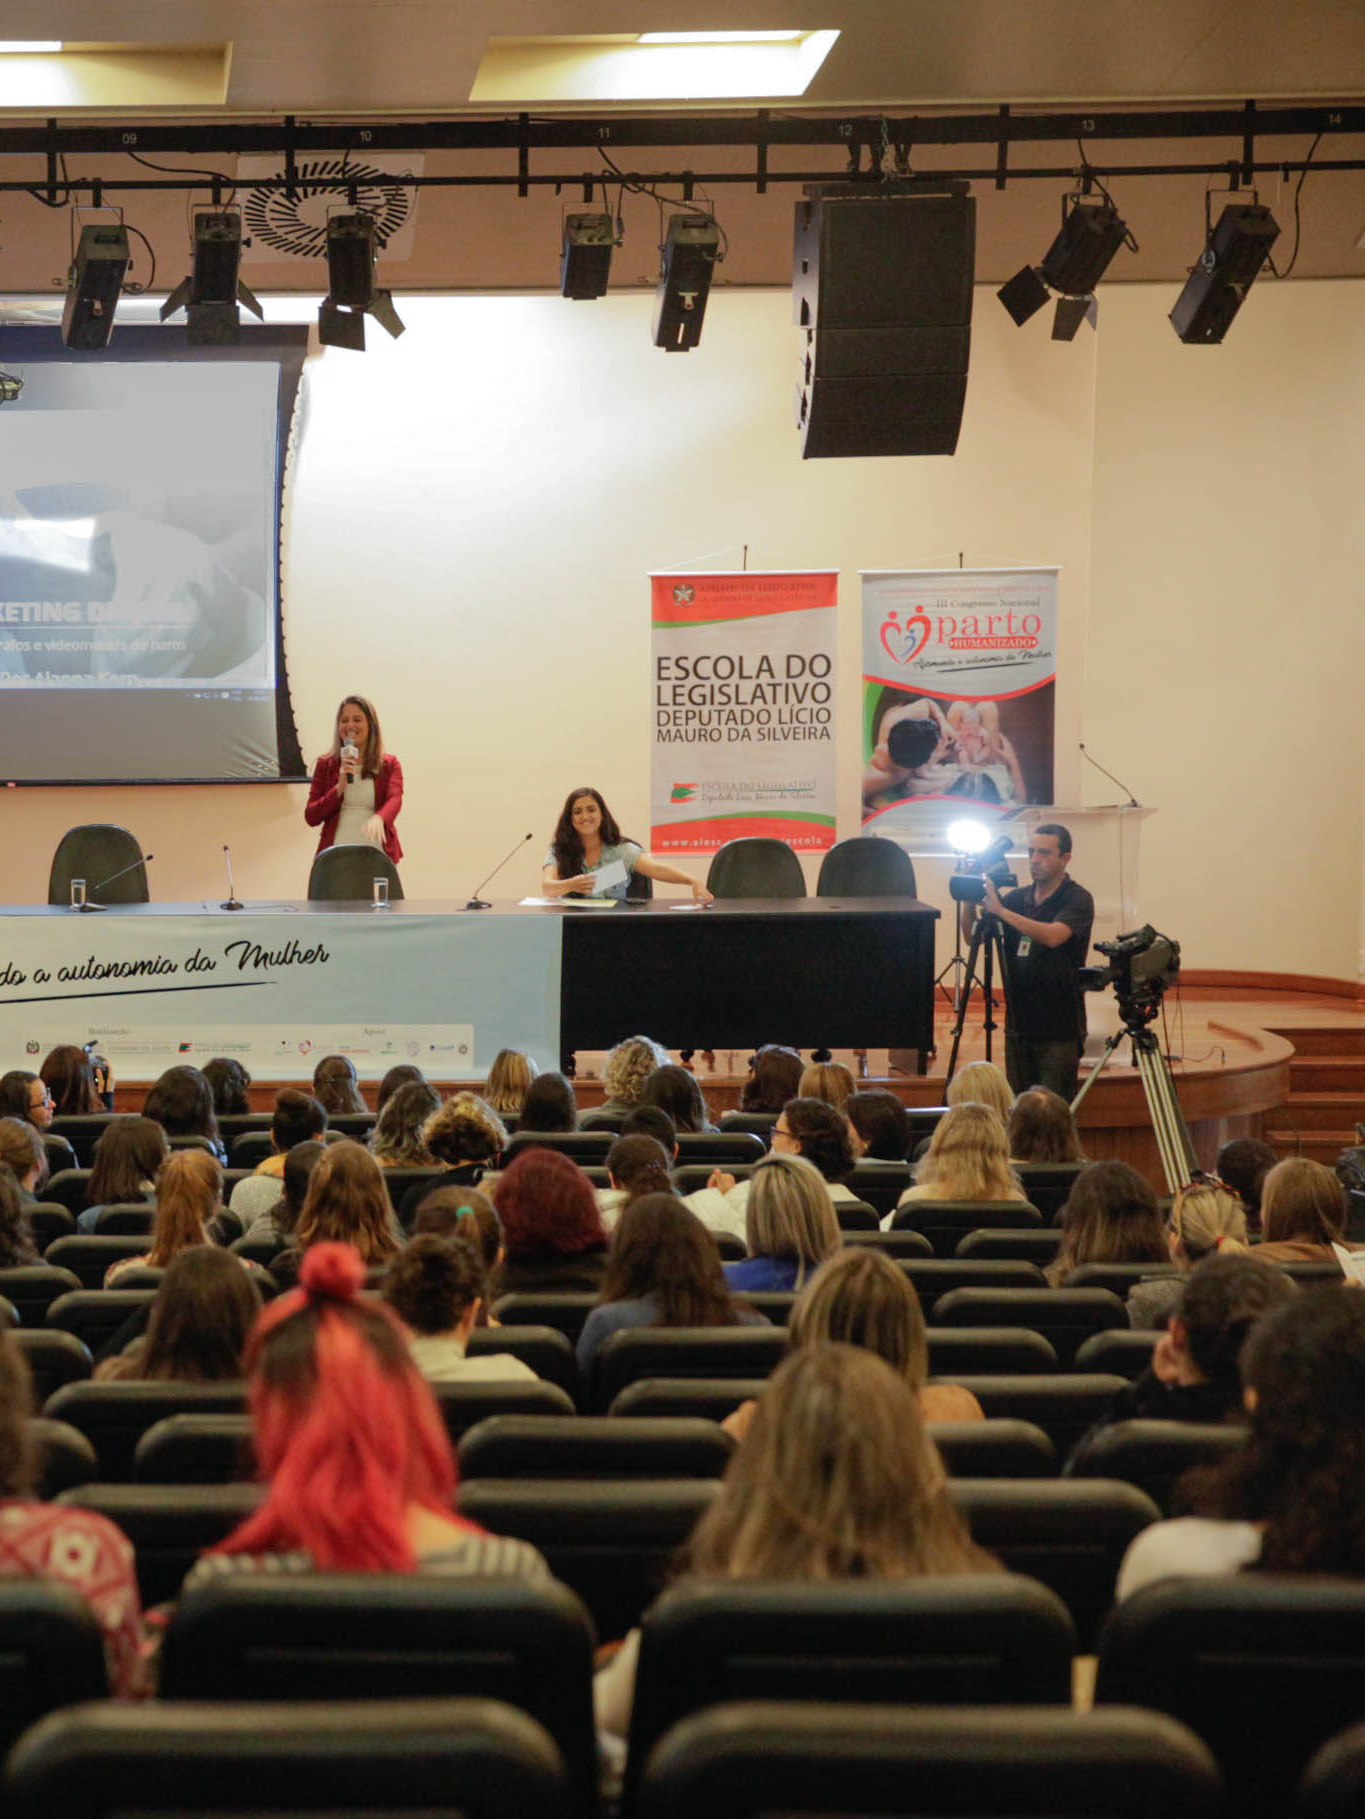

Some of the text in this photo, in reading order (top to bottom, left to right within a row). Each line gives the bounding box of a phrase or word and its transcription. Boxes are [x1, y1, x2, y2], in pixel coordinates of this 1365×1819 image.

[1082, 119, 1095, 131] 13
[1329, 114, 1341, 125] 14
[359, 130, 373, 141] 10
[598, 127, 610, 138] 11
[838, 124, 853, 136] 12
[122, 133, 138, 144] 09
[937, 608, 1042, 644] parto
[954, 637, 1031, 649] HUMANIZADO
[657, 654, 832, 681] ESCOLA DO
[657, 682, 832, 707] LEGISLATIVO
[657, 704, 831, 727] DEPUTADO LÍCIO
[657, 725, 831, 743] MAURO DA SILVEIRA
[33, 970, 50, 984] a
[57, 956, 178, 982] autonomia
[184, 949, 216, 973] da
[224, 940, 330, 970] Mulher
